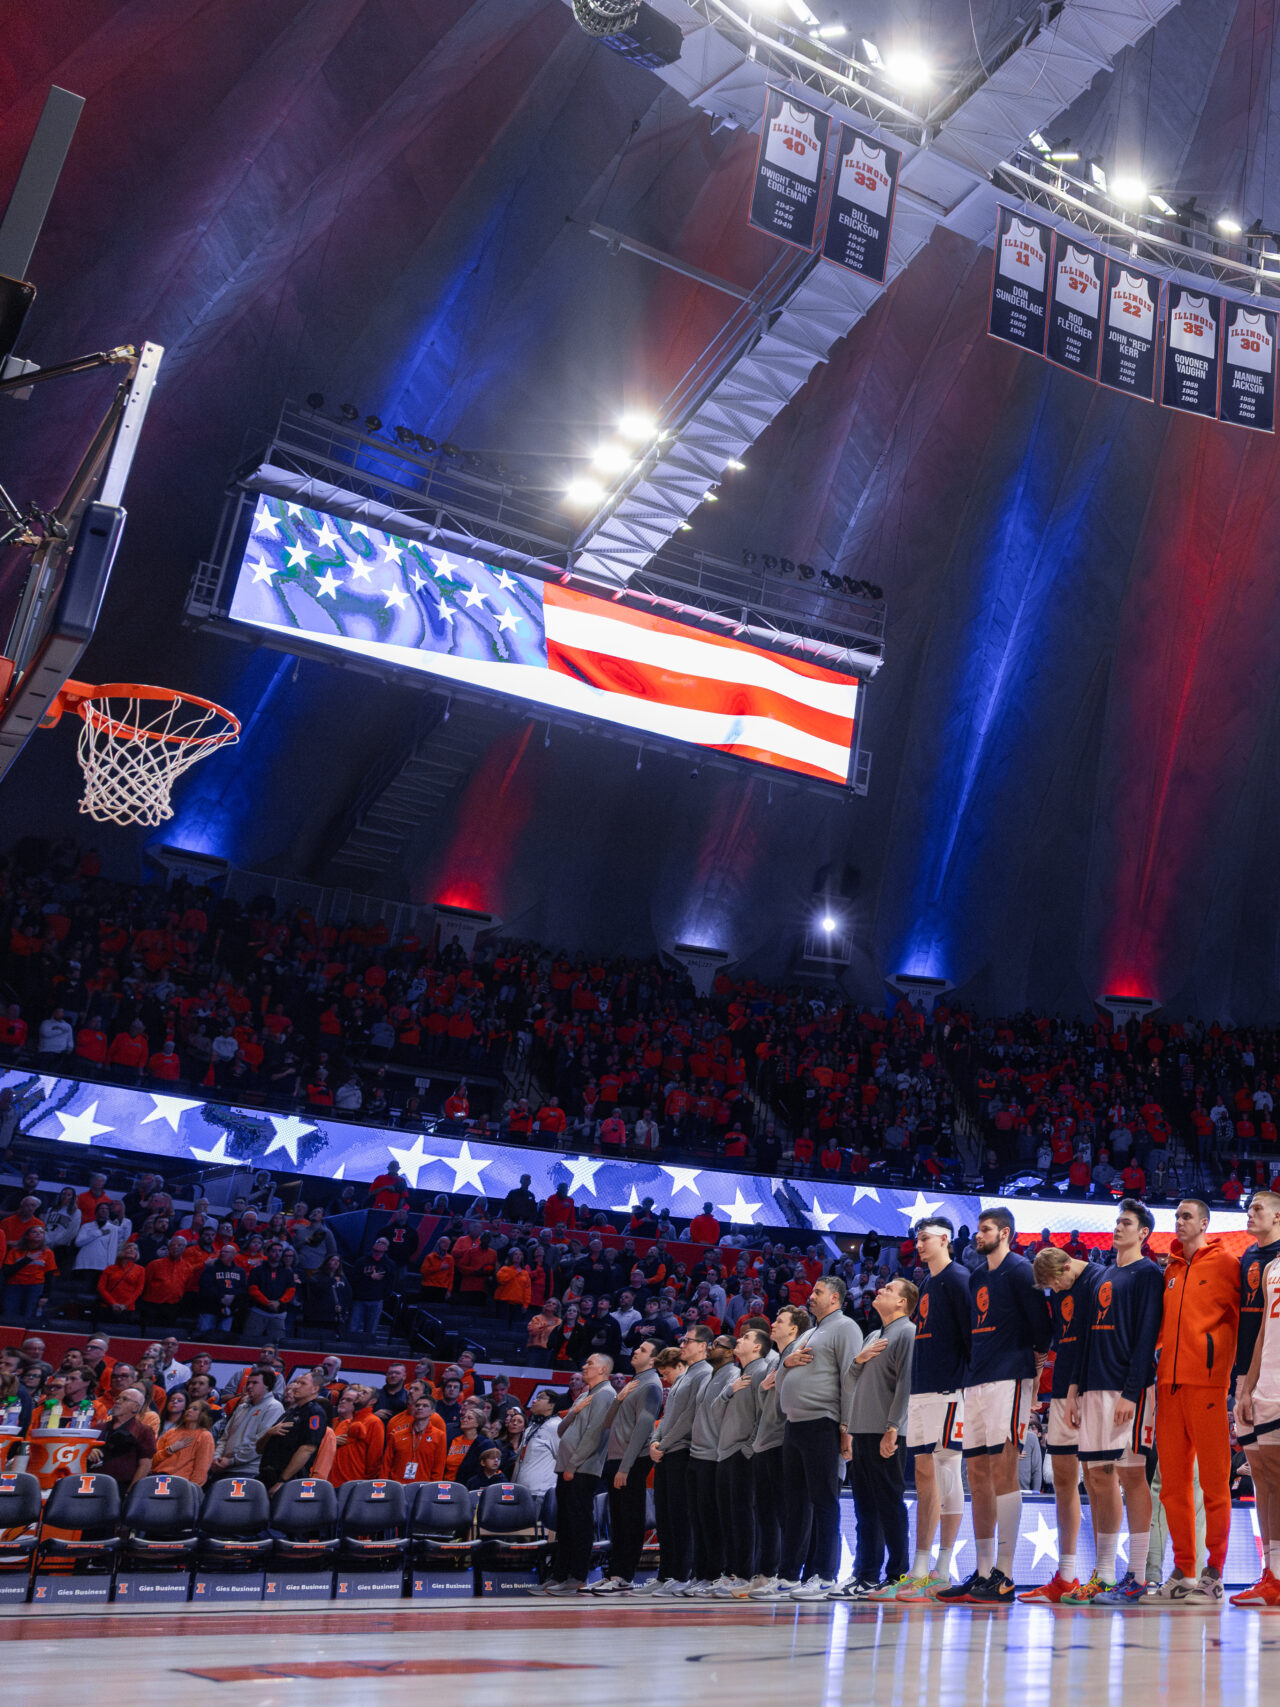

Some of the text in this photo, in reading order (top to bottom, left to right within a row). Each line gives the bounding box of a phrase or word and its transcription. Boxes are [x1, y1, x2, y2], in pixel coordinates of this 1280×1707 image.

[773, 123, 818, 151] ILLINOIS
[783, 137, 805, 155] 40
[761, 165, 816, 197] DWIGHT "DIKE"
[845, 159, 888, 187] ILLINOIS
[854, 171, 876, 191] 33
[768, 179, 808, 204] EDDLEMAN
[775, 200, 795, 212] 1947
[852, 208, 868, 225] BILL
[839, 213, 879, 240] ERICKSON
[1004, 238, 1043, 262] ILLINOIS
[1016, 251, 1030, 266] 11
[1060, 266, 1098, 289] ILLINOIS
[1069, 277, 1088, 294] 37
[1013, 285, 1028, 300] DON
[996, 288, 1044, 316] SUNDERLAGE
[1114, 291, 1152, 312] ILLINOIS
[1122, 301, 1141, 318] 22
[1069, 312, 1083, 326] ROD
[1174, 312, 1214, 331] ILLINOIS
[1058, 316, 1092, 340] FLETCHER
[1184, 321, 1203, 337] 35
[1109, 330, 1150, 352] JOHN "RED"
[1231, 329, 1270, 346] ILLINOIS
[1240, 338, 1260, 353] 30
[1119, 344, 1139, 358] KERR
[1175, 354, 1208, 371] GOVONER
[1176, 363, 1206, 380] VAUGHN
[1234, 370, 1263, 386] MANNIE
[1232, 379, 1265, 395] JACKSON
[57, 1446, 75, 1463] G
[75, 1588, 107, 1596] Business
[155, 1584, 186, 1592] Business
